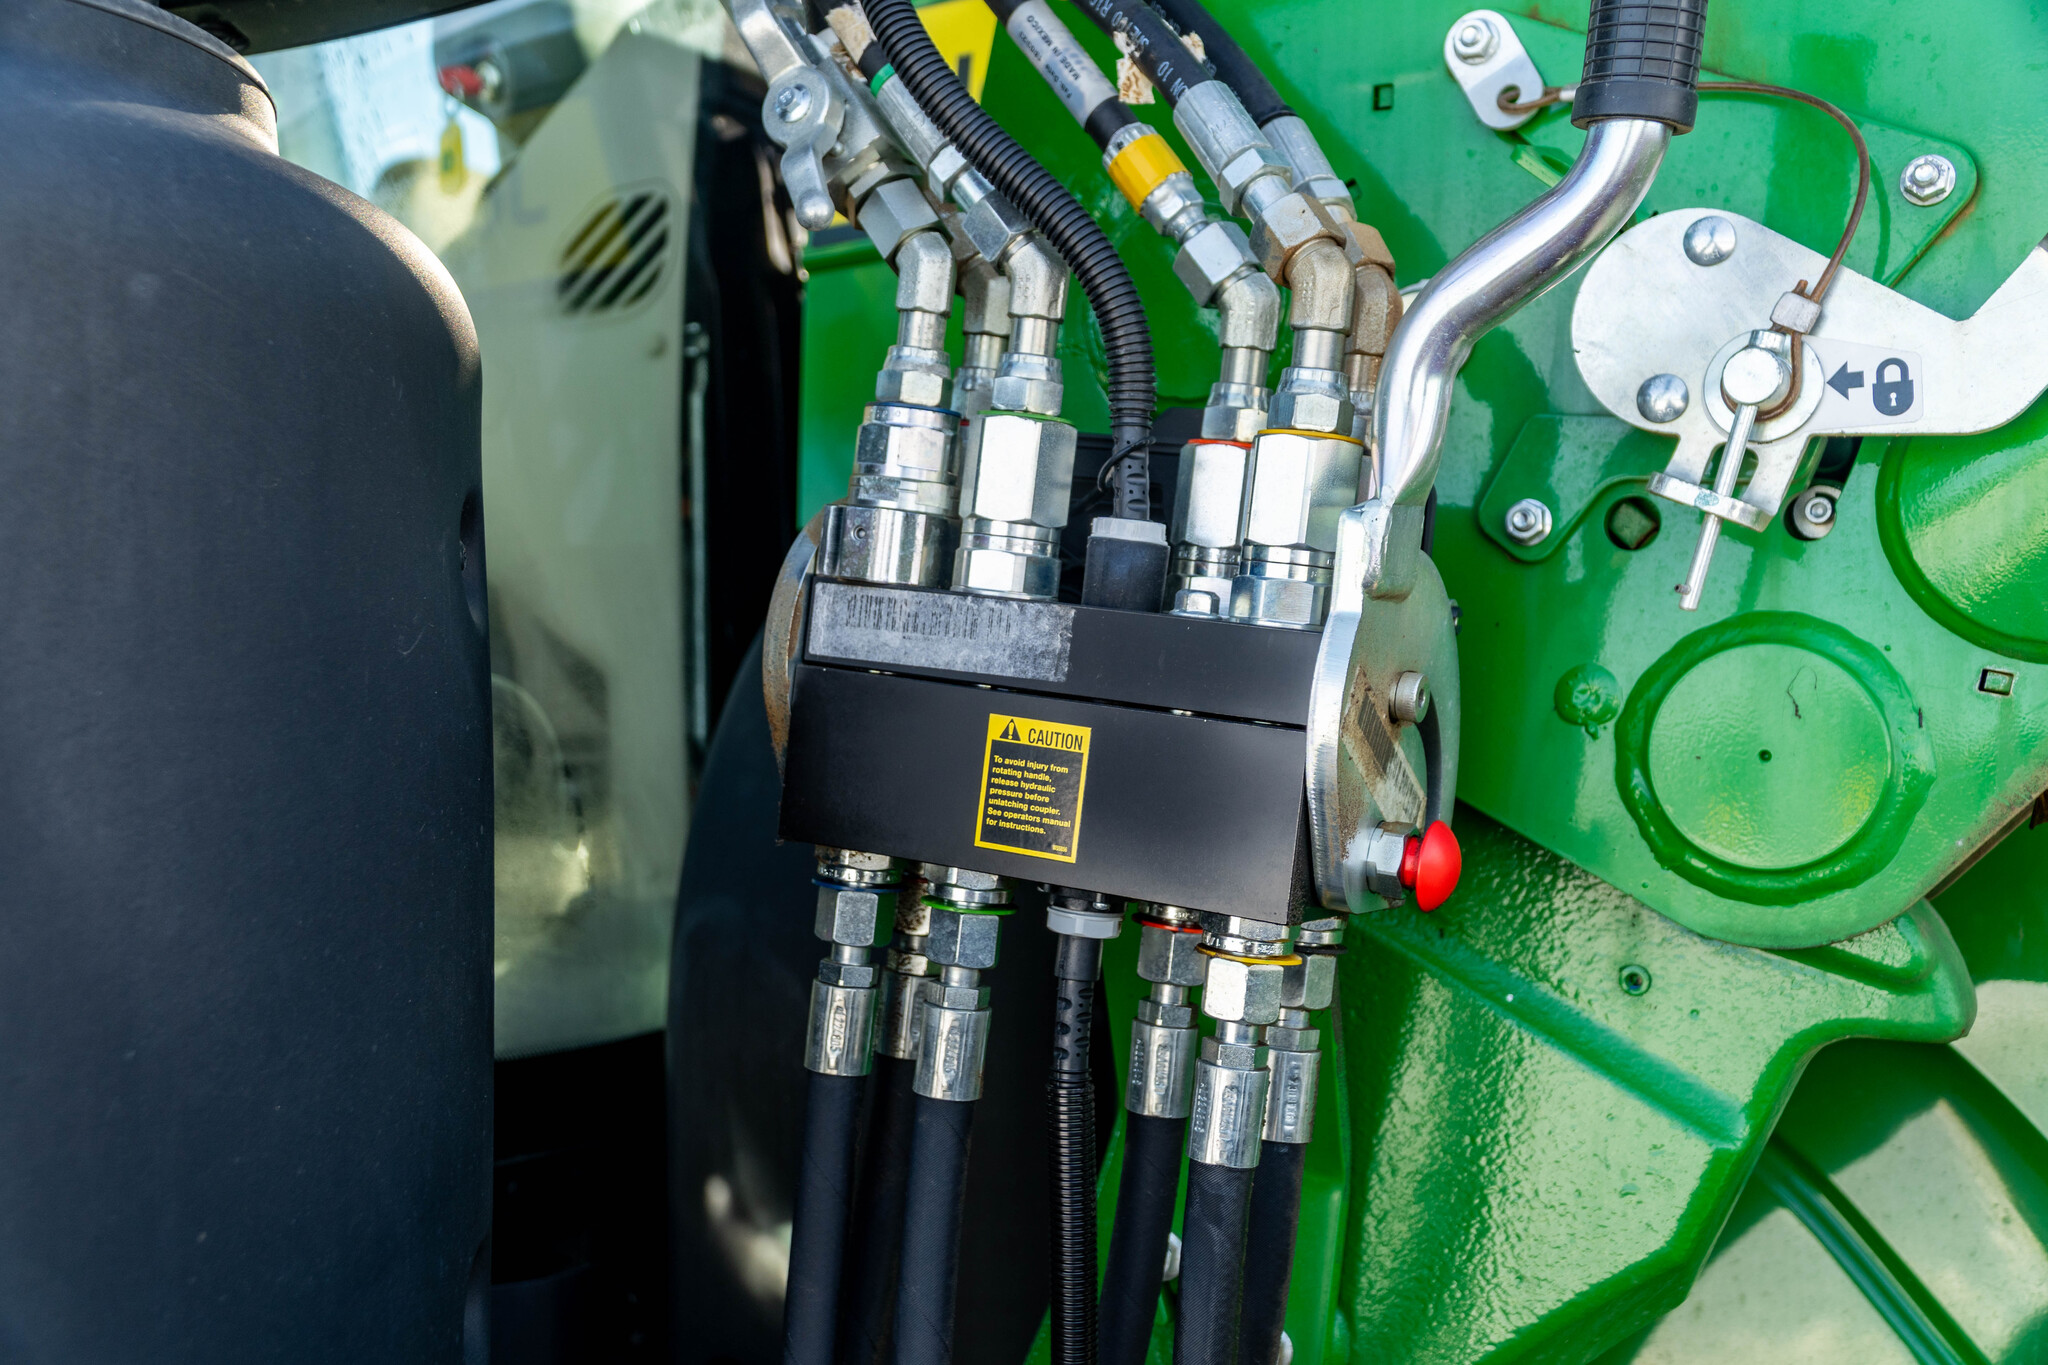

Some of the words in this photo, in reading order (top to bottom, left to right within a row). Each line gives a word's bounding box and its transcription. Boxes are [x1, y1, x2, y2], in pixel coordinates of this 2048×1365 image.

[1026, 15, 1053, 47] MEXICO
[1157, 61, 1174, 82] 10
[1028, 728, 1083, 751] CAUTION
[994, 755, 1003, 764] To
[1004, 758, 1026, 767] avoid
[1026, 760, 1049, 772] injury
[1050, 764, 1069, 774] from
[992, 767, 1022, 778] rotating
[1024, 771, 1052, 782] handle,
[991, 777, 1019, 787] release
[1020, 780, 1056, 793] hydraulic
[990, 787, 1023, 798] pressure
[1024, 792, 1050, 803] before
[988, 798, 1028, 811] unlatching
[1030, 804, 1061, 816] coupler.
[986, 817, 997, 826] for
[999, 819, 1047, 834] instructions.
[987, 807, 1002, 816] See
[1003, 810, 1040, 823] operators
[1042, 817, 1071, 828] manual
